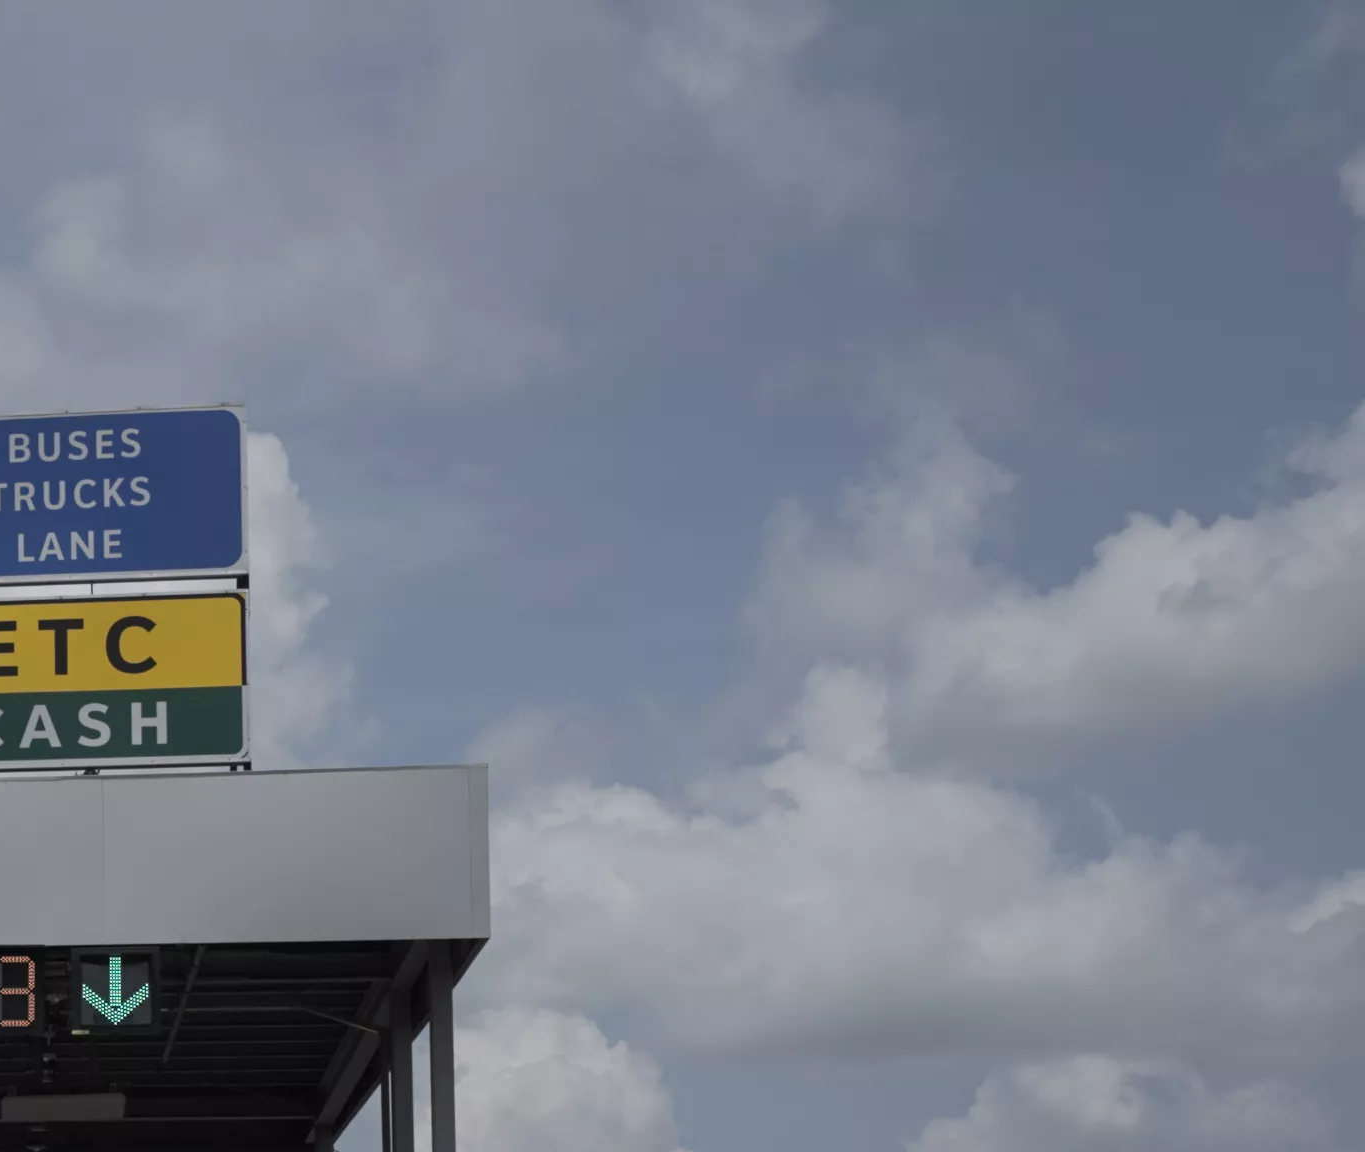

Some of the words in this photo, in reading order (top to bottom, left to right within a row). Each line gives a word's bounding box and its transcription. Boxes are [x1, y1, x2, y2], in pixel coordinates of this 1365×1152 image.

[7, 427, 142, 464] BUSES
[16, 528, 124, 563] LANE
[0, 955, 36, 1028] 3
